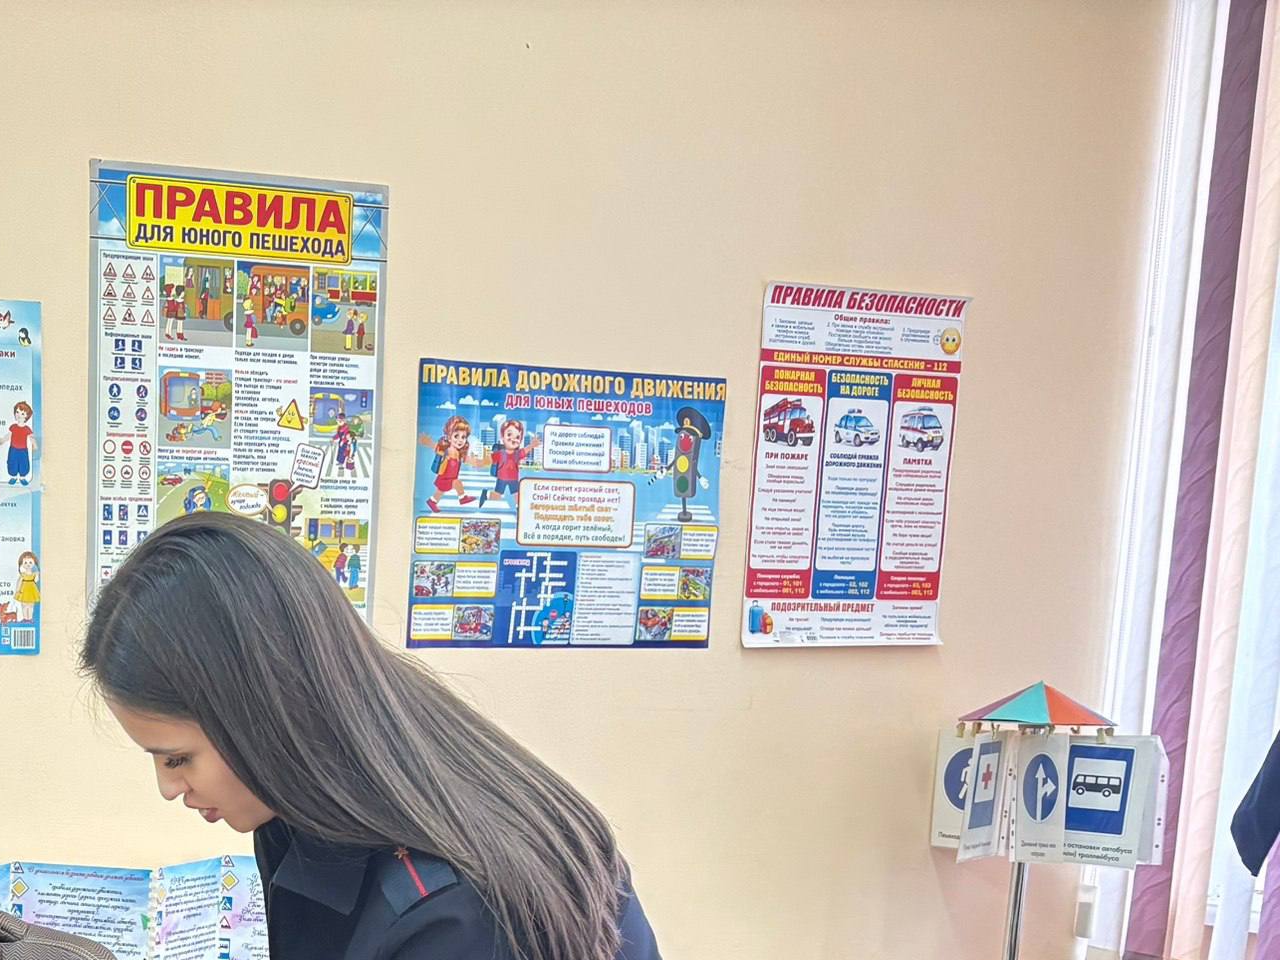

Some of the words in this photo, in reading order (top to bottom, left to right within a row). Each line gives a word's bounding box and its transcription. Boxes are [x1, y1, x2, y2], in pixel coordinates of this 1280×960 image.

[136, 182, 346, 234] ПРАВИЛА
[135, 223, 174, 243] ДЛЯ
[182, 227, 242, 247] ЮНОГО
[249, 233, 346, 258] ПЕШЕХОДА
[770, 285, 846, 309] ПРАВИЛА
[848, 292, 966, 318] БЕЗОПАСНОСТИ
[834, 314, 858, 323] Общие
[859, 316, 891, 325] правила:
[774, 351, 810, 362] ЕДИНЫЙ
[812, 355, 841, 365] НОМЕР
[843, 356, 880, 367] СЛУЖБЫ
[883, 359, 924, 369] СПАСЕНИЯ
[933, 362, 948, 370] 112
[774, 369, 815, 380] ПОЖАРНАЯ
[831, 372, 889, 386] БЕЗОПАСНОСТЬ
[422, 364, 511, 388] ПРАВИЛА
[516, 370, 625, 395] ДОРОЖНОГО
[631, 378, 726, 400] ДВИЖЕНИЯ
[765, 380, 823, 393] БЕЗОПАСНОСТЬ
[911, 378, 941, 388] ЛИЧНАЯ
[840, 386, 850, 395] НА
[851, 385, 879, 398] ДОРОГЕ
[897, 388, 953, 401] БЕЗОПАСНОСТЬ
[765, 452, 779, 460] ПРИ
[781, 452, 808, 461] ПОЖАРЕ
[543, 533, 573, 541] порядке,
[771, 602, 840, 613] ПОДОЗРИТЕЛЬНЫЙ
[842, 603, 875, 613] ПРЕДМЕТ
[1102, 846, 1132, 854] автобуса
